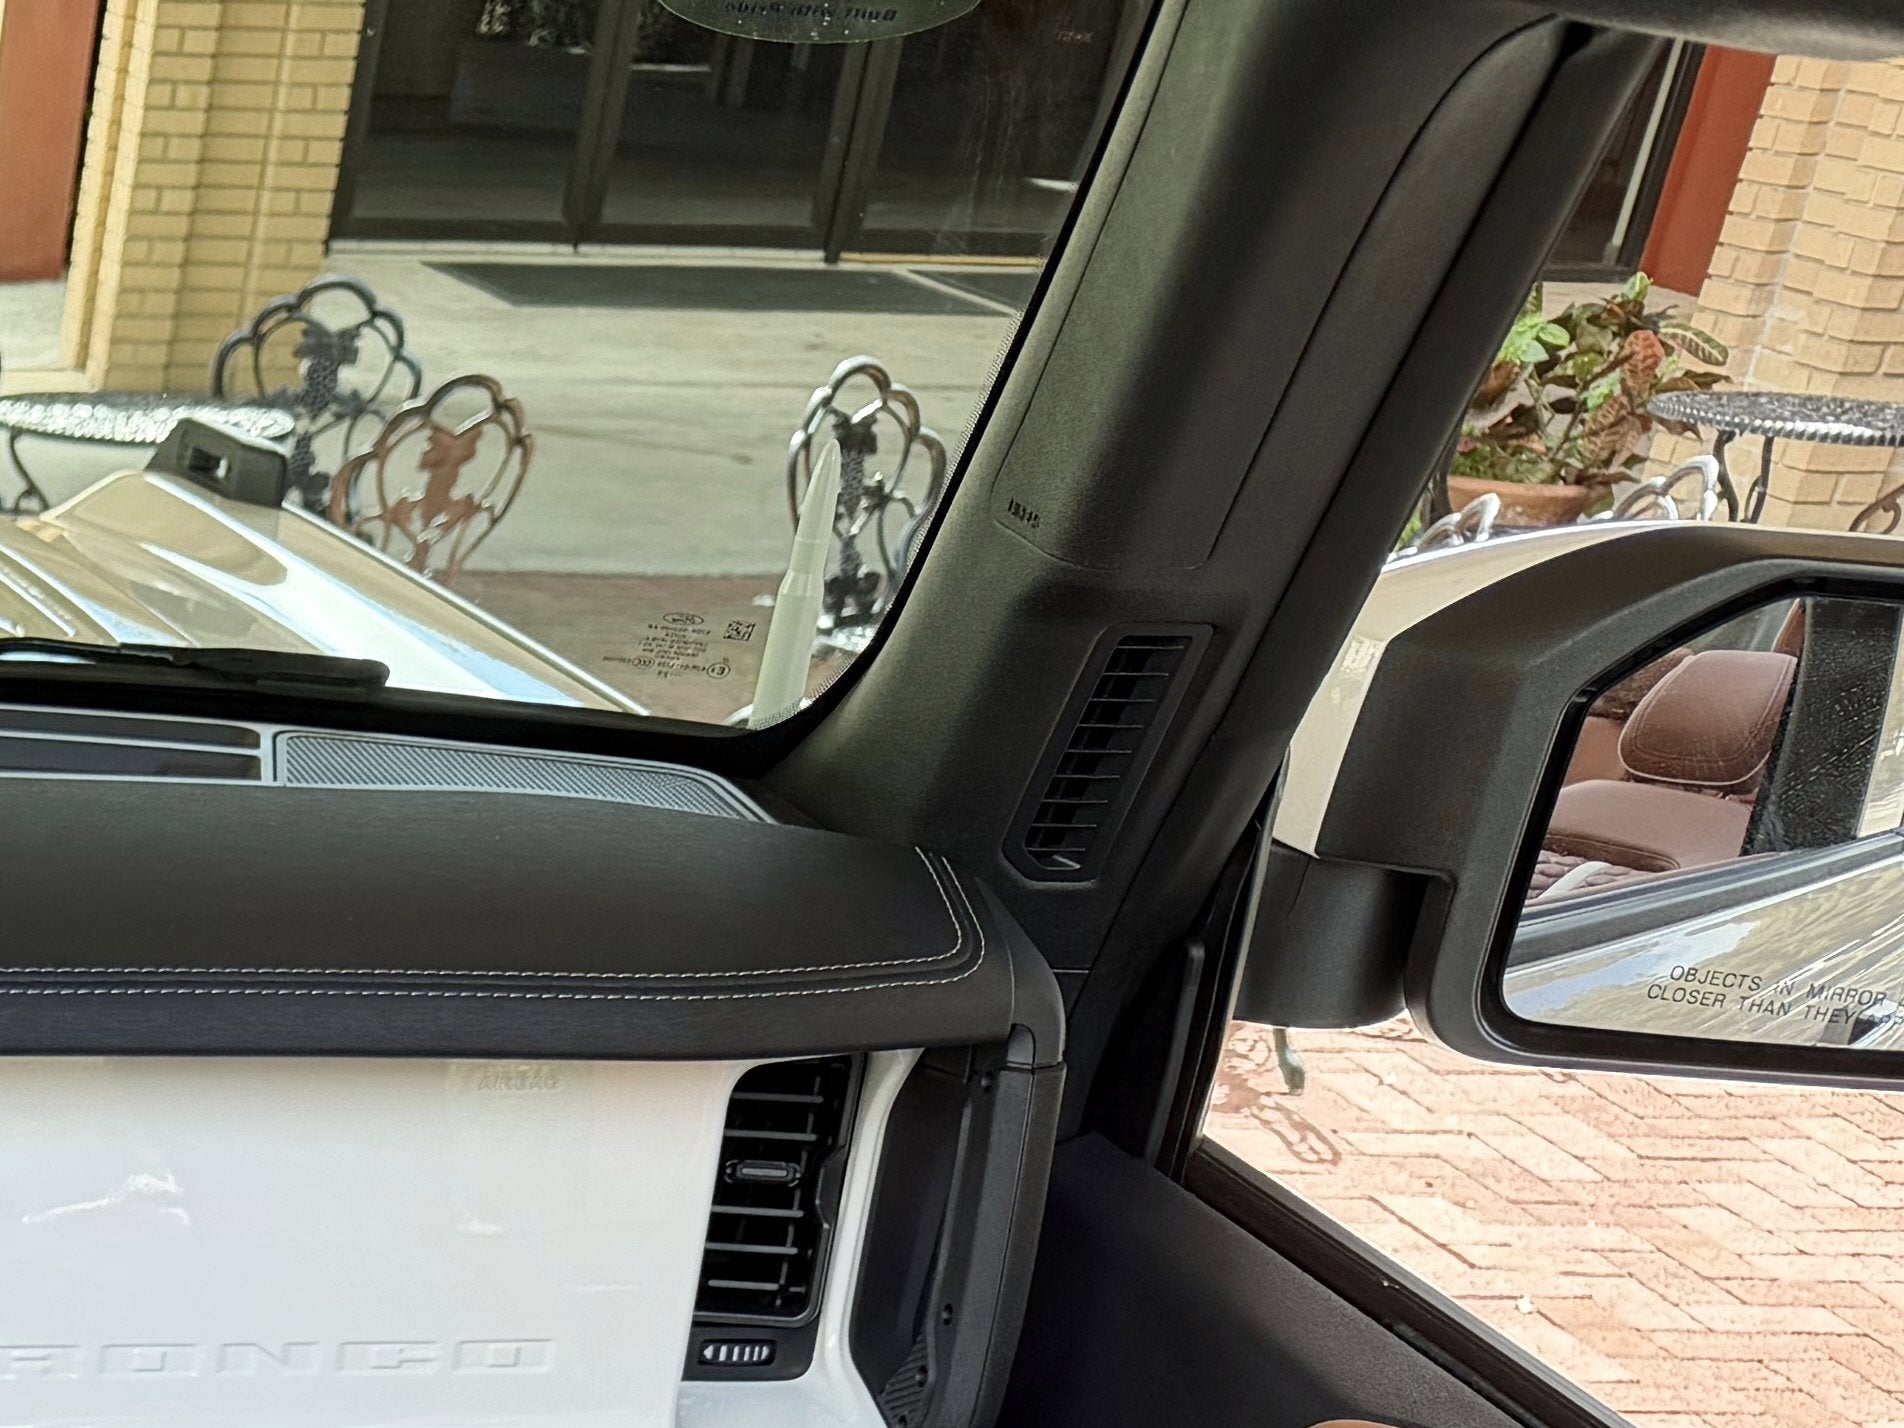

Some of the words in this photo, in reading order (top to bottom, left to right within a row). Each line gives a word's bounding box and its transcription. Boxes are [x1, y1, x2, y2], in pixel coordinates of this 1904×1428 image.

[1647, 984, 1727, 1008] CLOSER
[1739, 996, 1791, 1016] THAN
[1804, 1005, 1856, 1025] THEY
[1670, 965, 1763, 992] OBJECTS
[1807, 983, 1887, 1006] MIRROR
